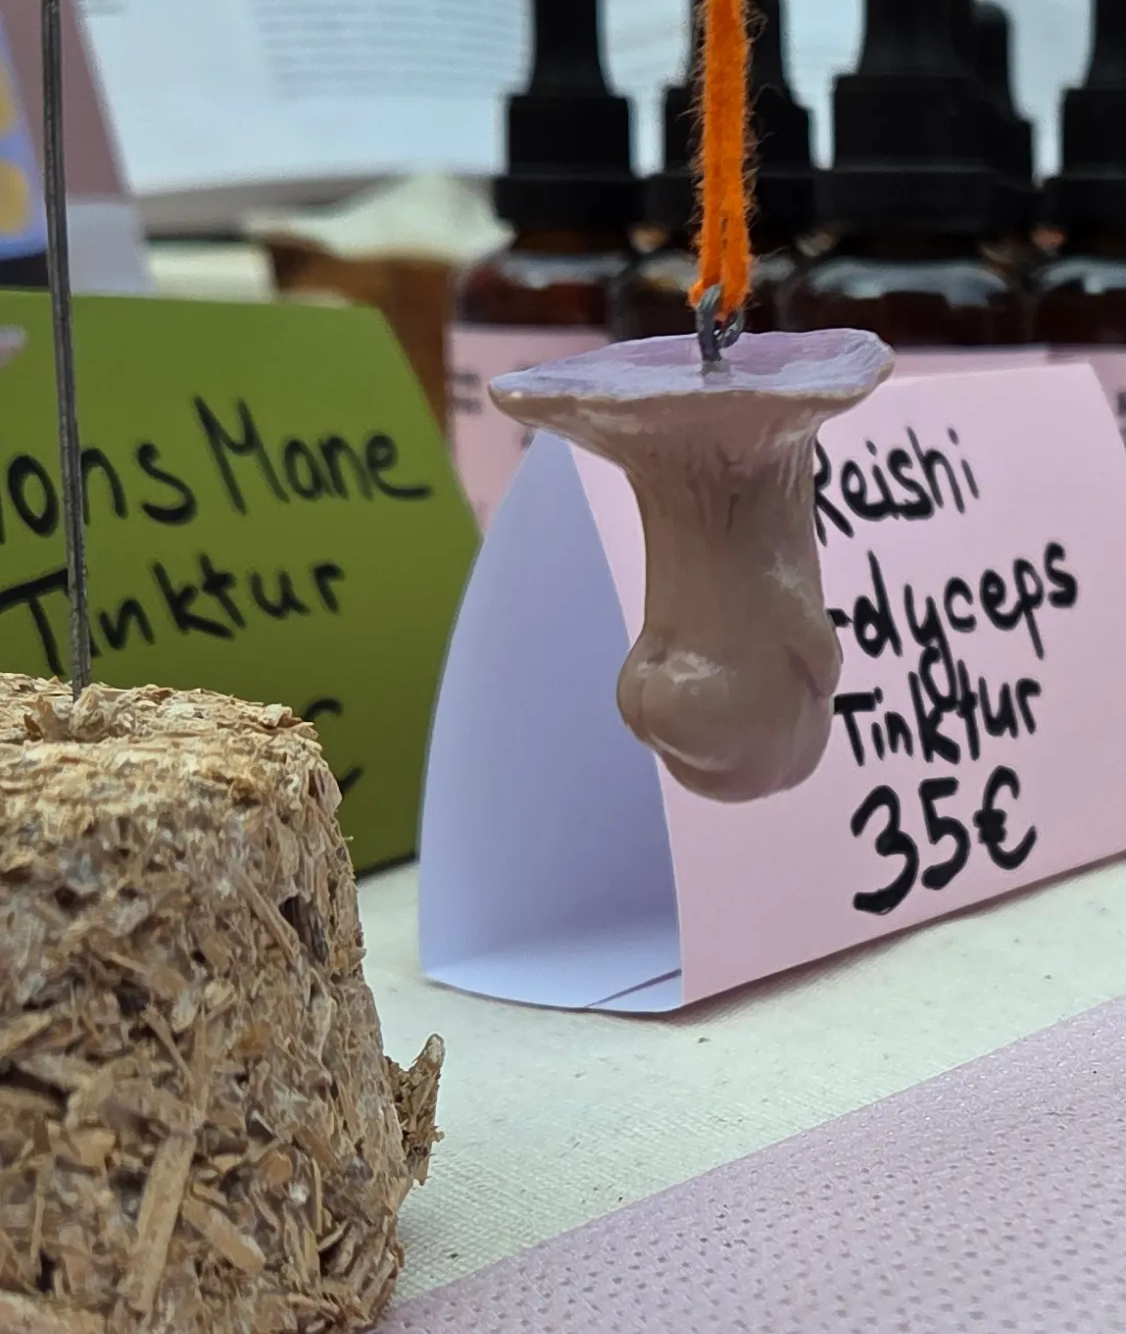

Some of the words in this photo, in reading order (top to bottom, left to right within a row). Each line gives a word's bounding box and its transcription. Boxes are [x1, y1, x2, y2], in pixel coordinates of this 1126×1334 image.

[0, 441, 198, 547] ons
[193, 394, 433, 515] Mane
[813, 426, 980, 545] Reishi
[0, 553, 345, 676] Tnktur
[826, 541, 1079, 713] dyceps
[833, 659, 1042, 767] Tinktur
[850, 765, 1038, 915] 35€
